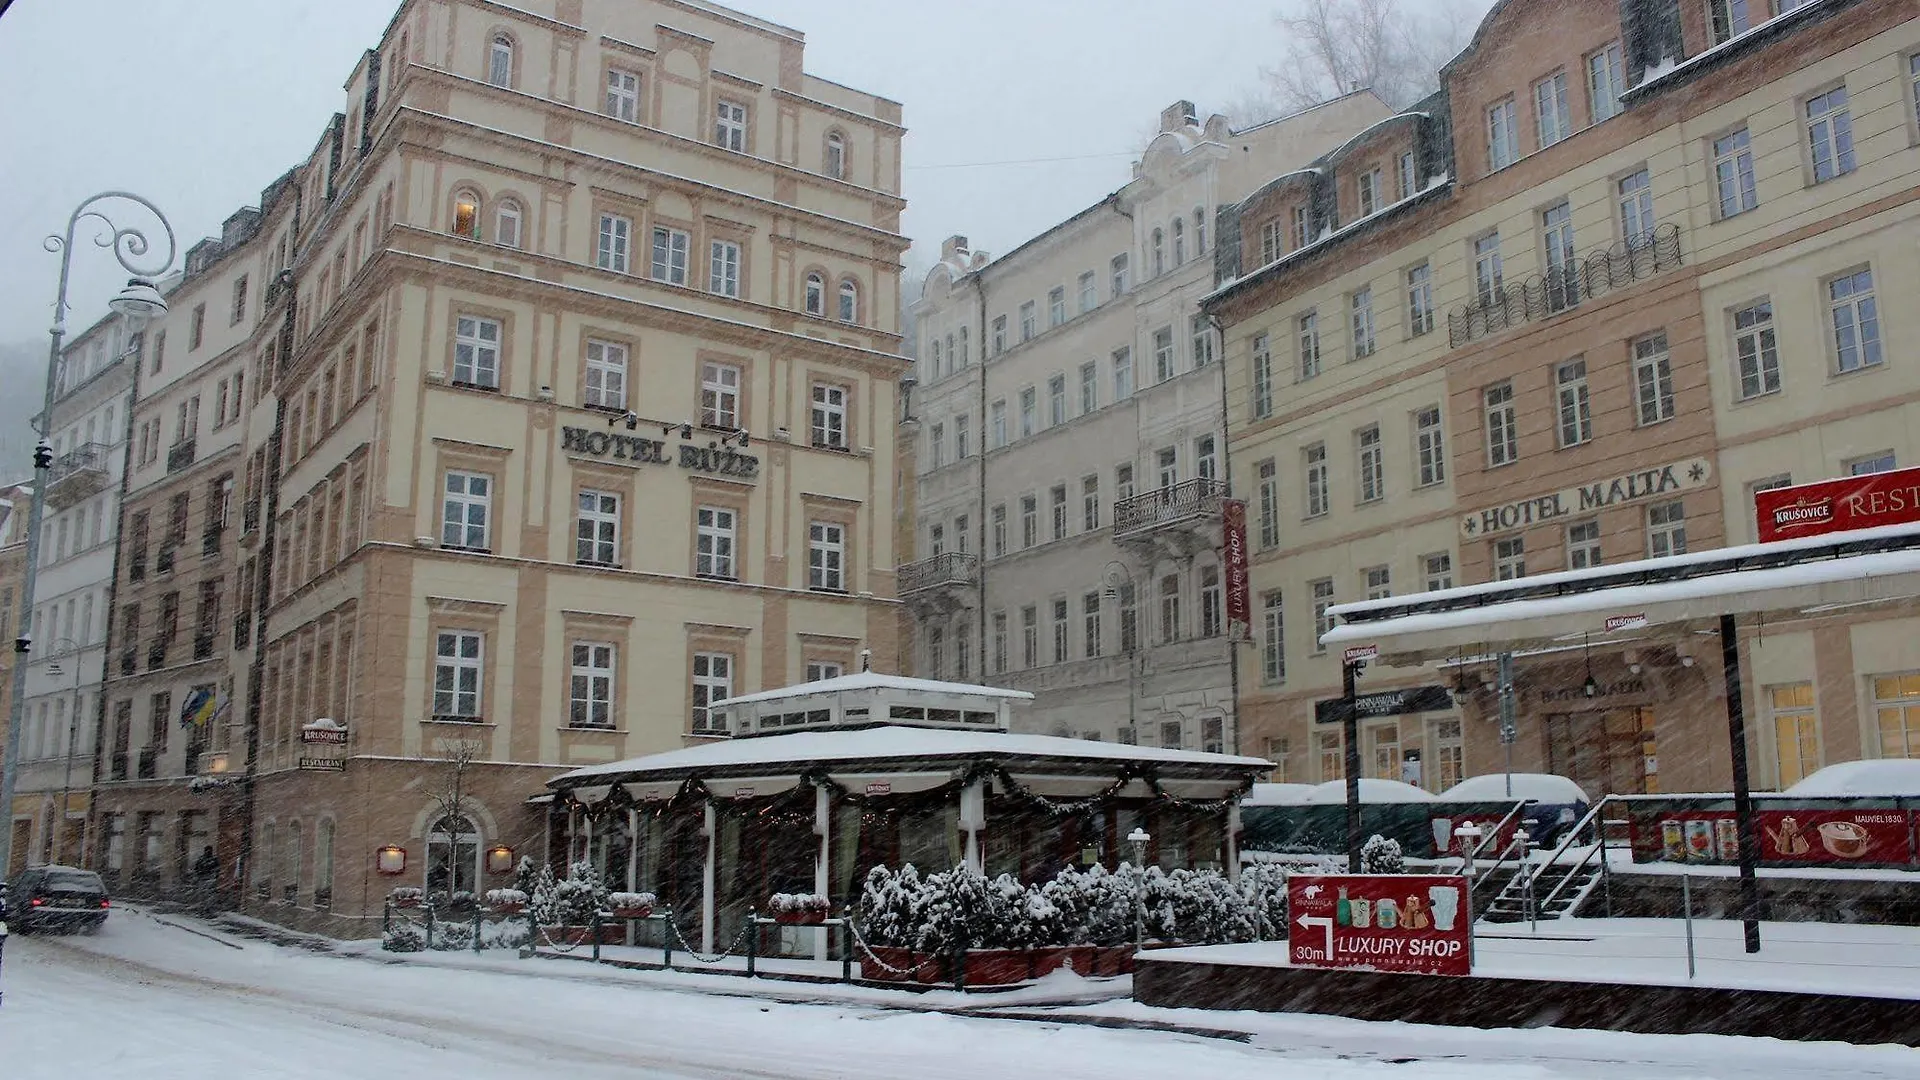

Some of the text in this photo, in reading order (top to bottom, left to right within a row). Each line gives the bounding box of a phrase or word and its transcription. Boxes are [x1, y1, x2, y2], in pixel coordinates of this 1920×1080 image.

[561, 425, 760, 478] HOTEL RŮŽE
[1481, 464, 1680, 533] HOTEL MALTA
[1851, 486, 1920, 517] REST
[1775, 505, 1829, 524] KRUŠOVICE
[1230, 529, 1243, 613] LUXURY SHOP
[1355, 693, 1405, 710] PINNAWALA
[1296, 946, 1324, 961] 30m
[1338, 936, 1461, 957] LUXURY SHOP
